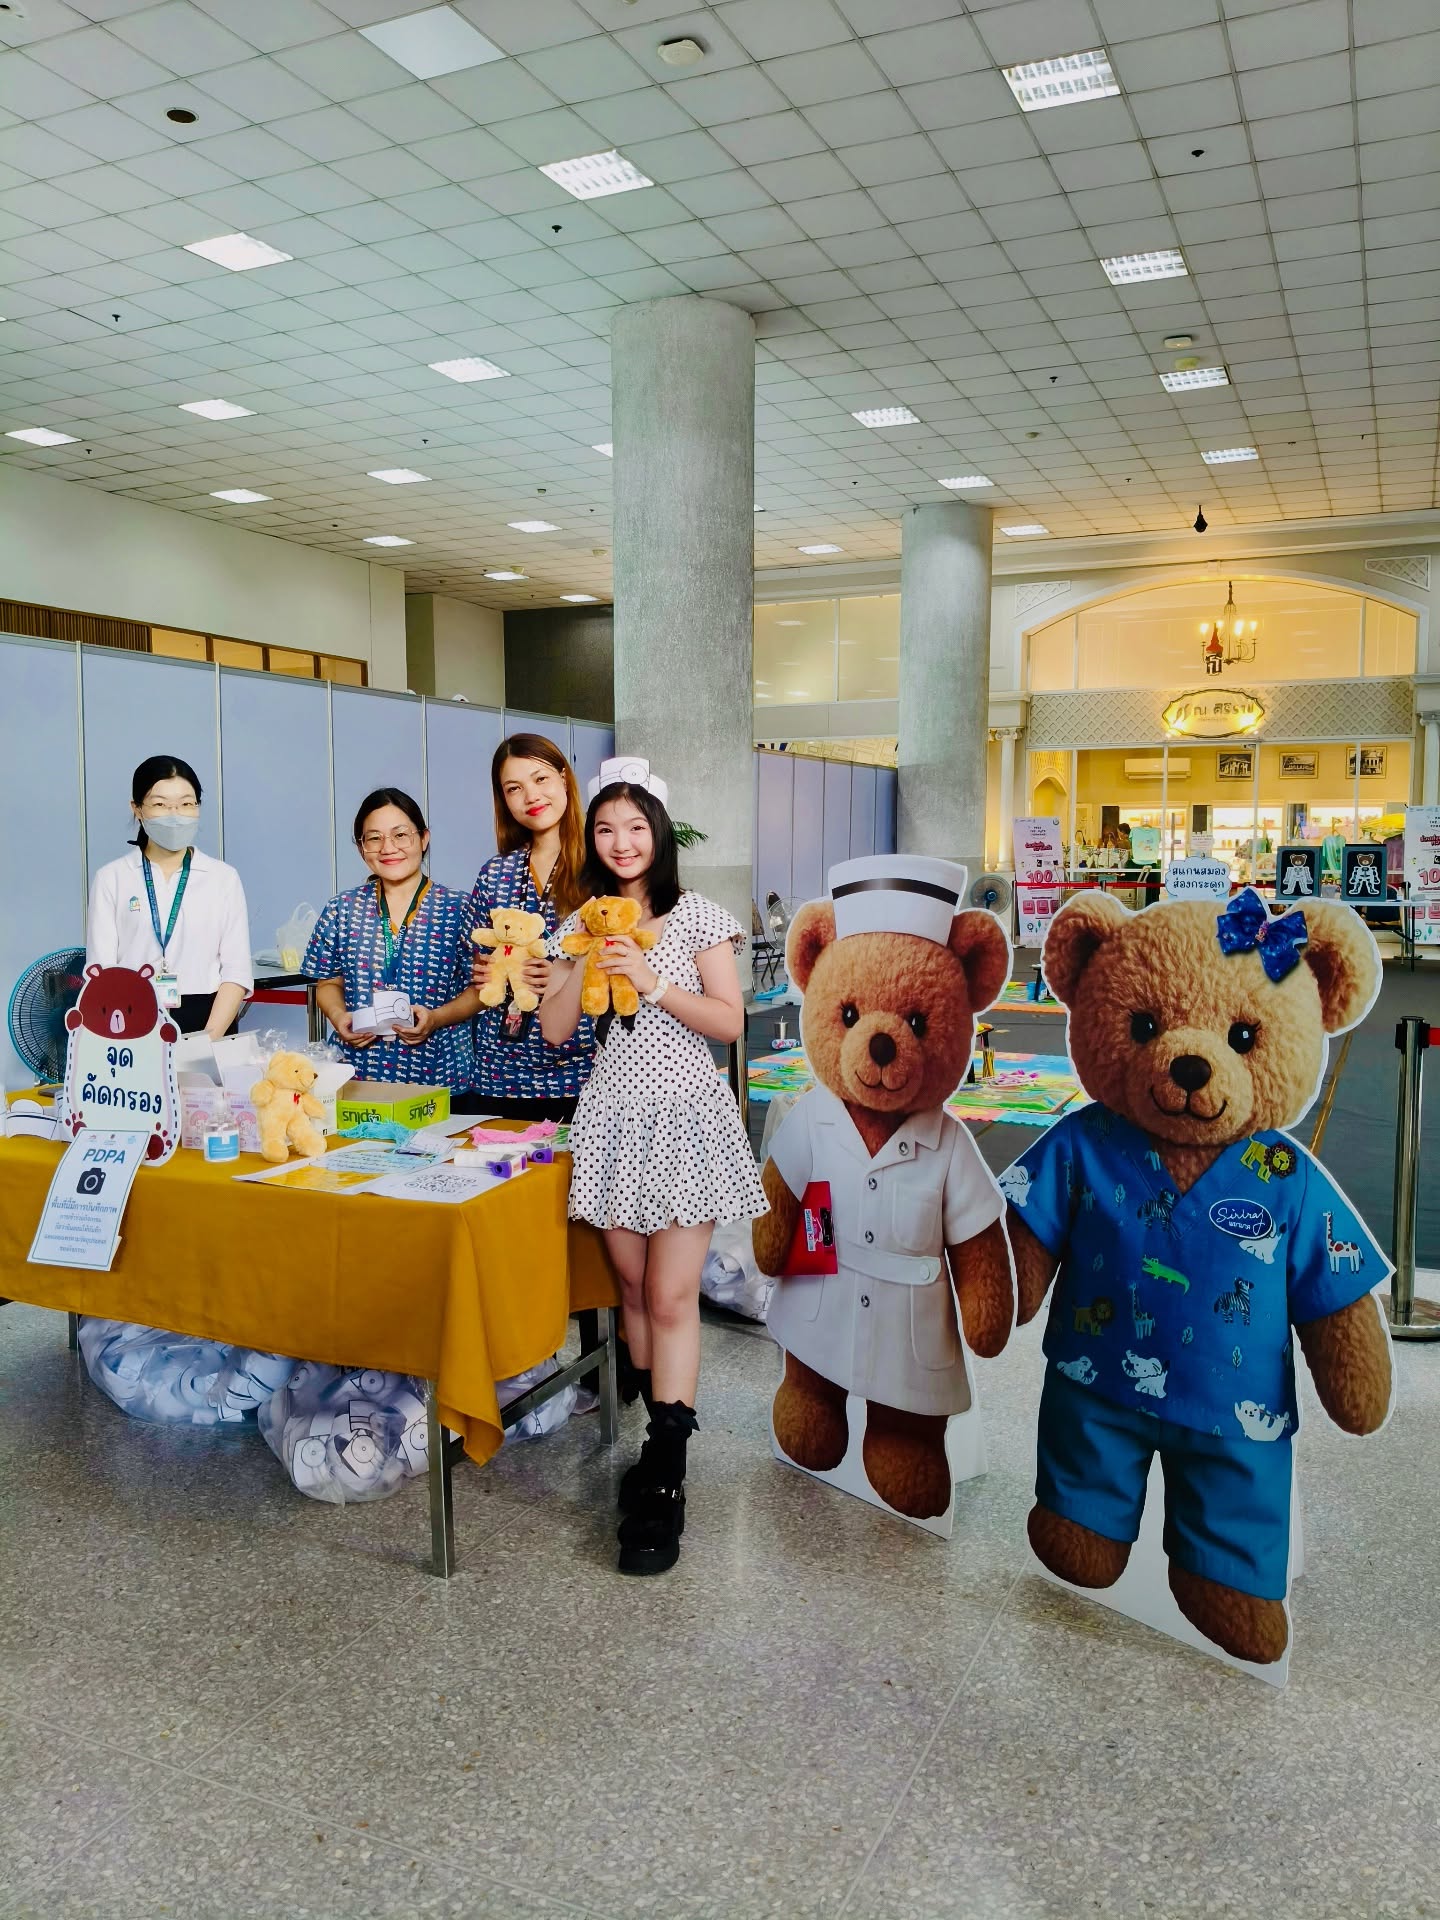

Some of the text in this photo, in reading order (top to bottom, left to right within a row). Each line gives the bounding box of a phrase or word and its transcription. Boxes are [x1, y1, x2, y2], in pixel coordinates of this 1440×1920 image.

[1172, 867, 1226, 876] สแกนสมอง
[1173, 877, 1225, 893] ส่องกระดูก
[106, 1046, 134, 1078] จุด
[82, 1072, 163, 1115] คัดกรอง
[83, 1148, 126, 1164] PDPA
